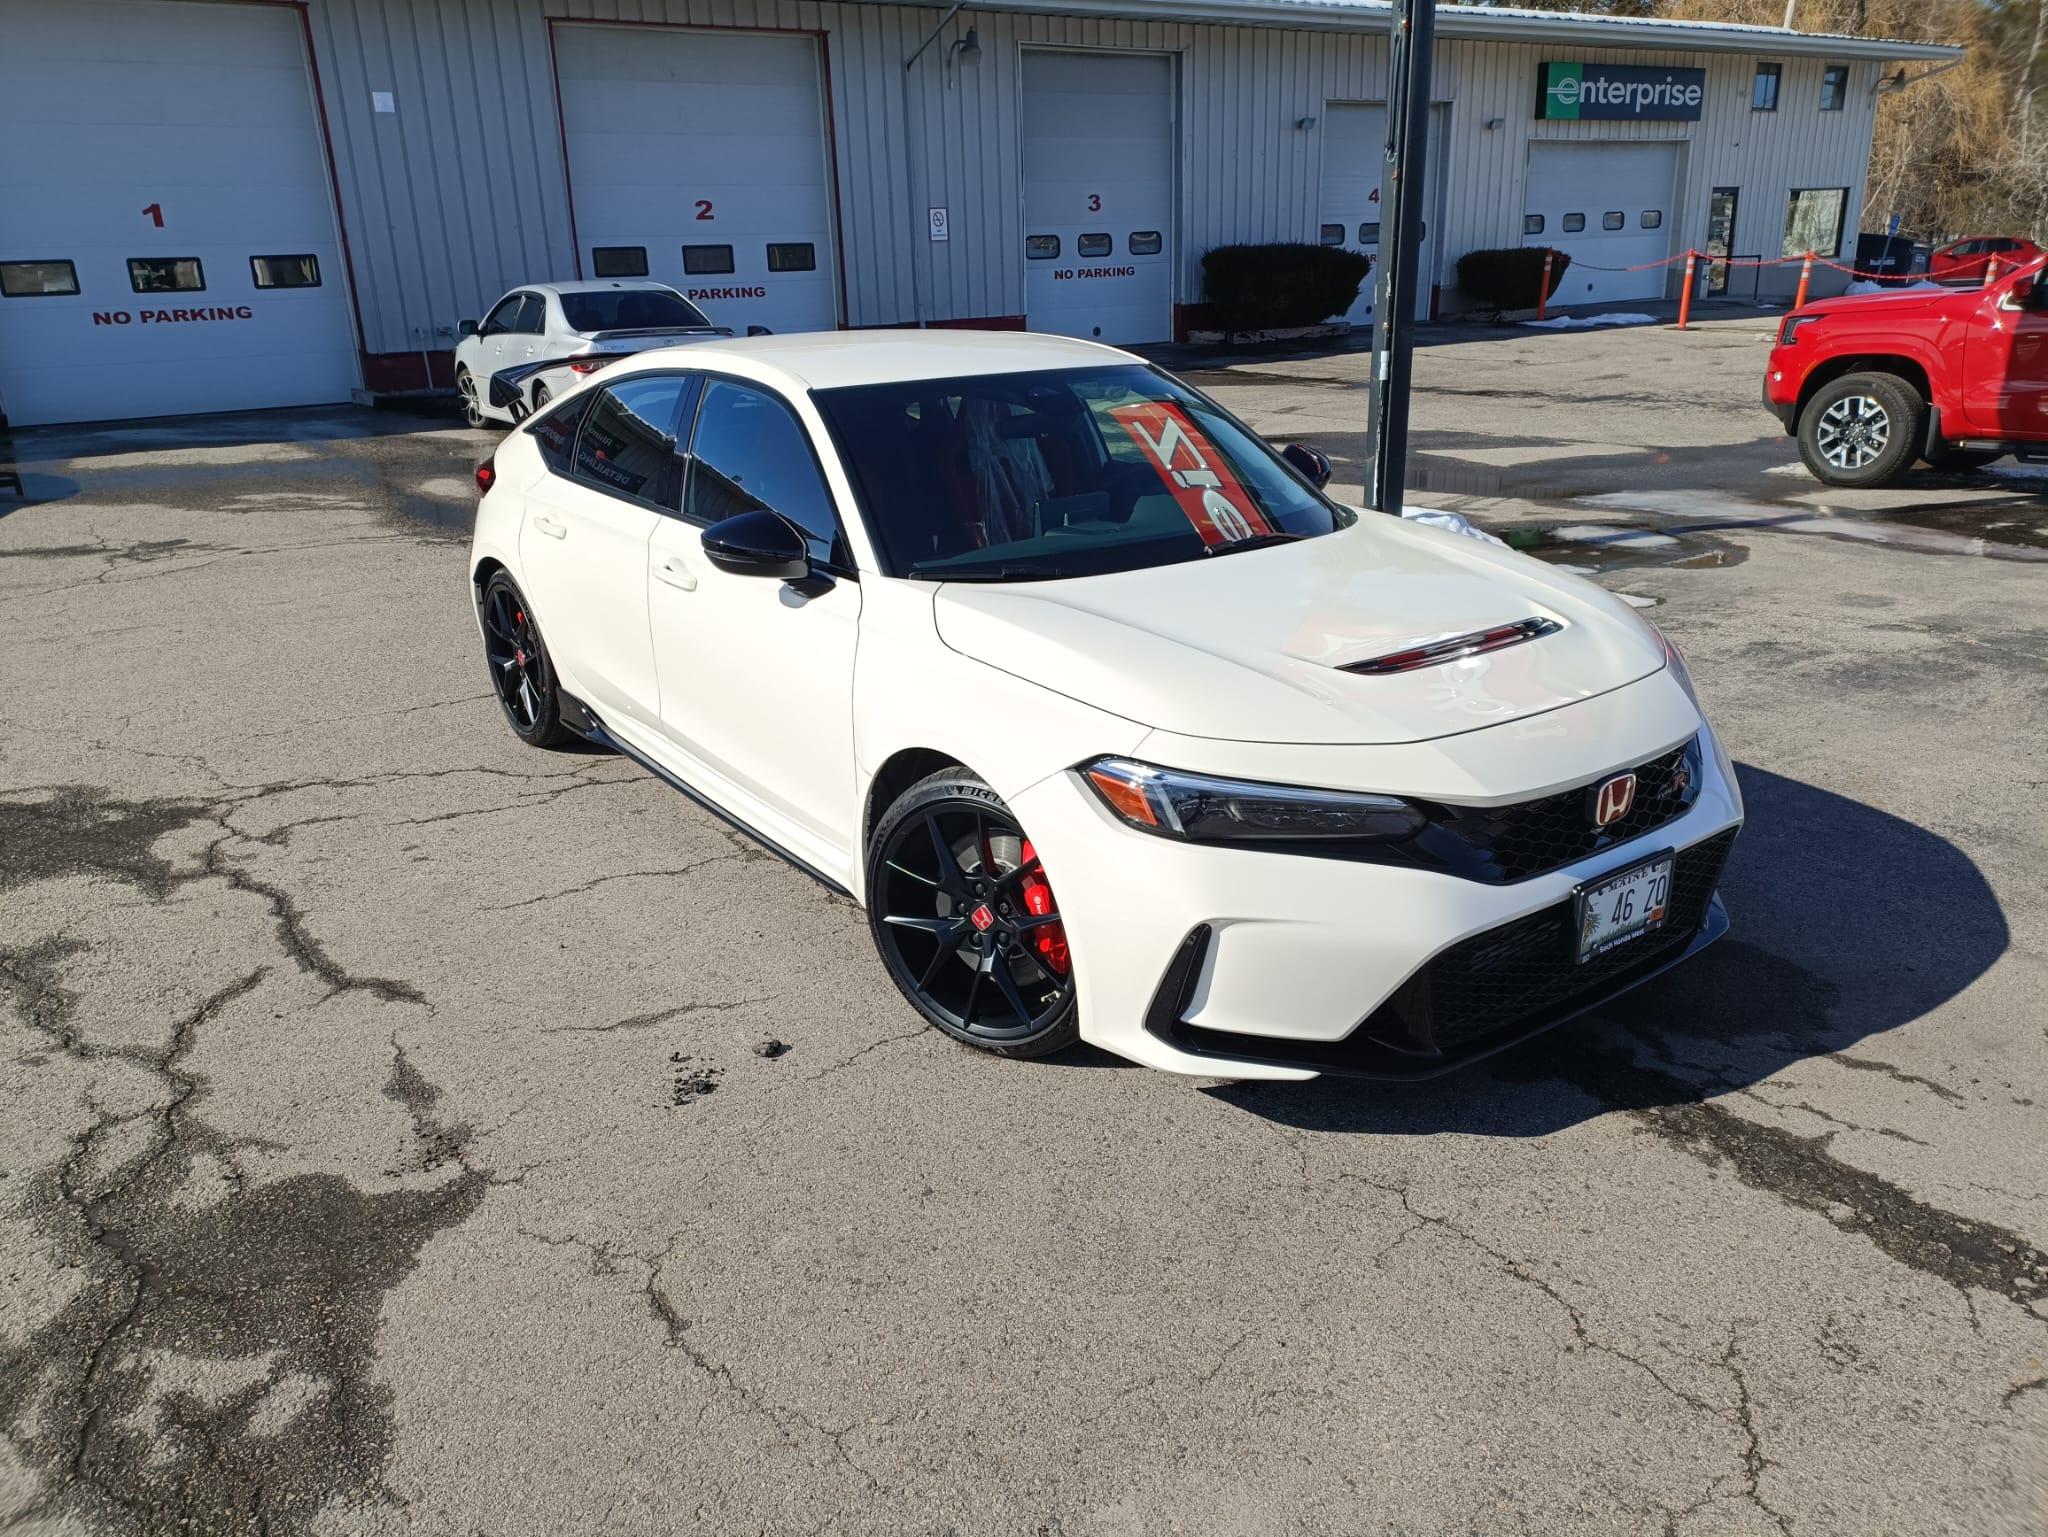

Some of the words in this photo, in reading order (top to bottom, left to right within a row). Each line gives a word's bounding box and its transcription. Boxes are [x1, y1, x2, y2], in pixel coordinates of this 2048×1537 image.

[1547, 76, 1702, 112] enterprise
[1087, 193, 1102, 212] 3
[1368, 187, 1380, 204] 4
[142, 203, 164, 228] 1
[694, 199, 714, 221] 2
[1054, 269, 1074, 280] NO
[1077, 266, 1136, 279] PARKING
[687, 286, 767, 300] PARKING
[92, 311, 132, 326] NO
[139, 306, 253, 324] PARKING
[1611, 888, 1636, 926] 46
